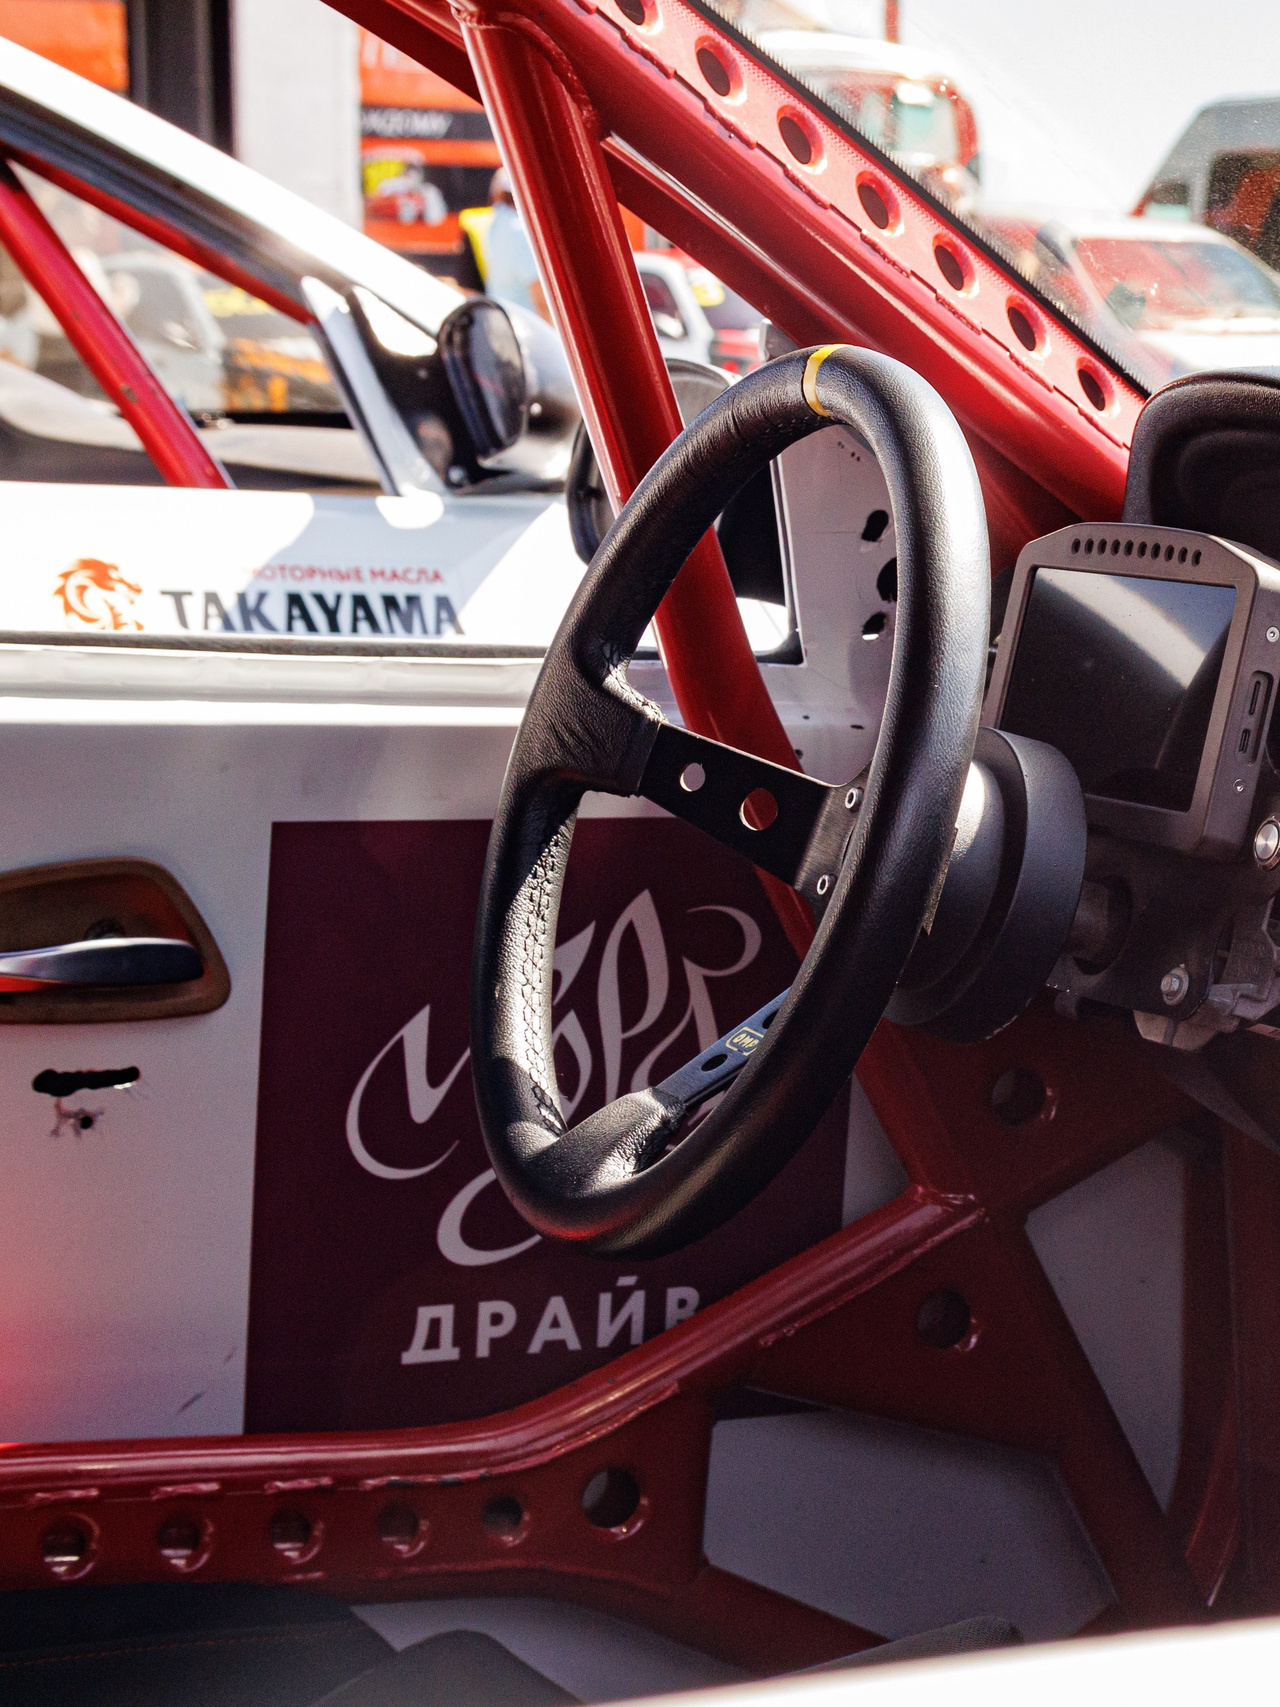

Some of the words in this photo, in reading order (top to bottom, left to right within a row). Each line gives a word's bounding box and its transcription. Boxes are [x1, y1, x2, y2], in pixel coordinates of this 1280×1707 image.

[246, 565, 362, 583] ОТОРНЫЕ
[368, 566, 444, 584] МАСЛА
[160, 589, 466, 636] TAKAYAMA
